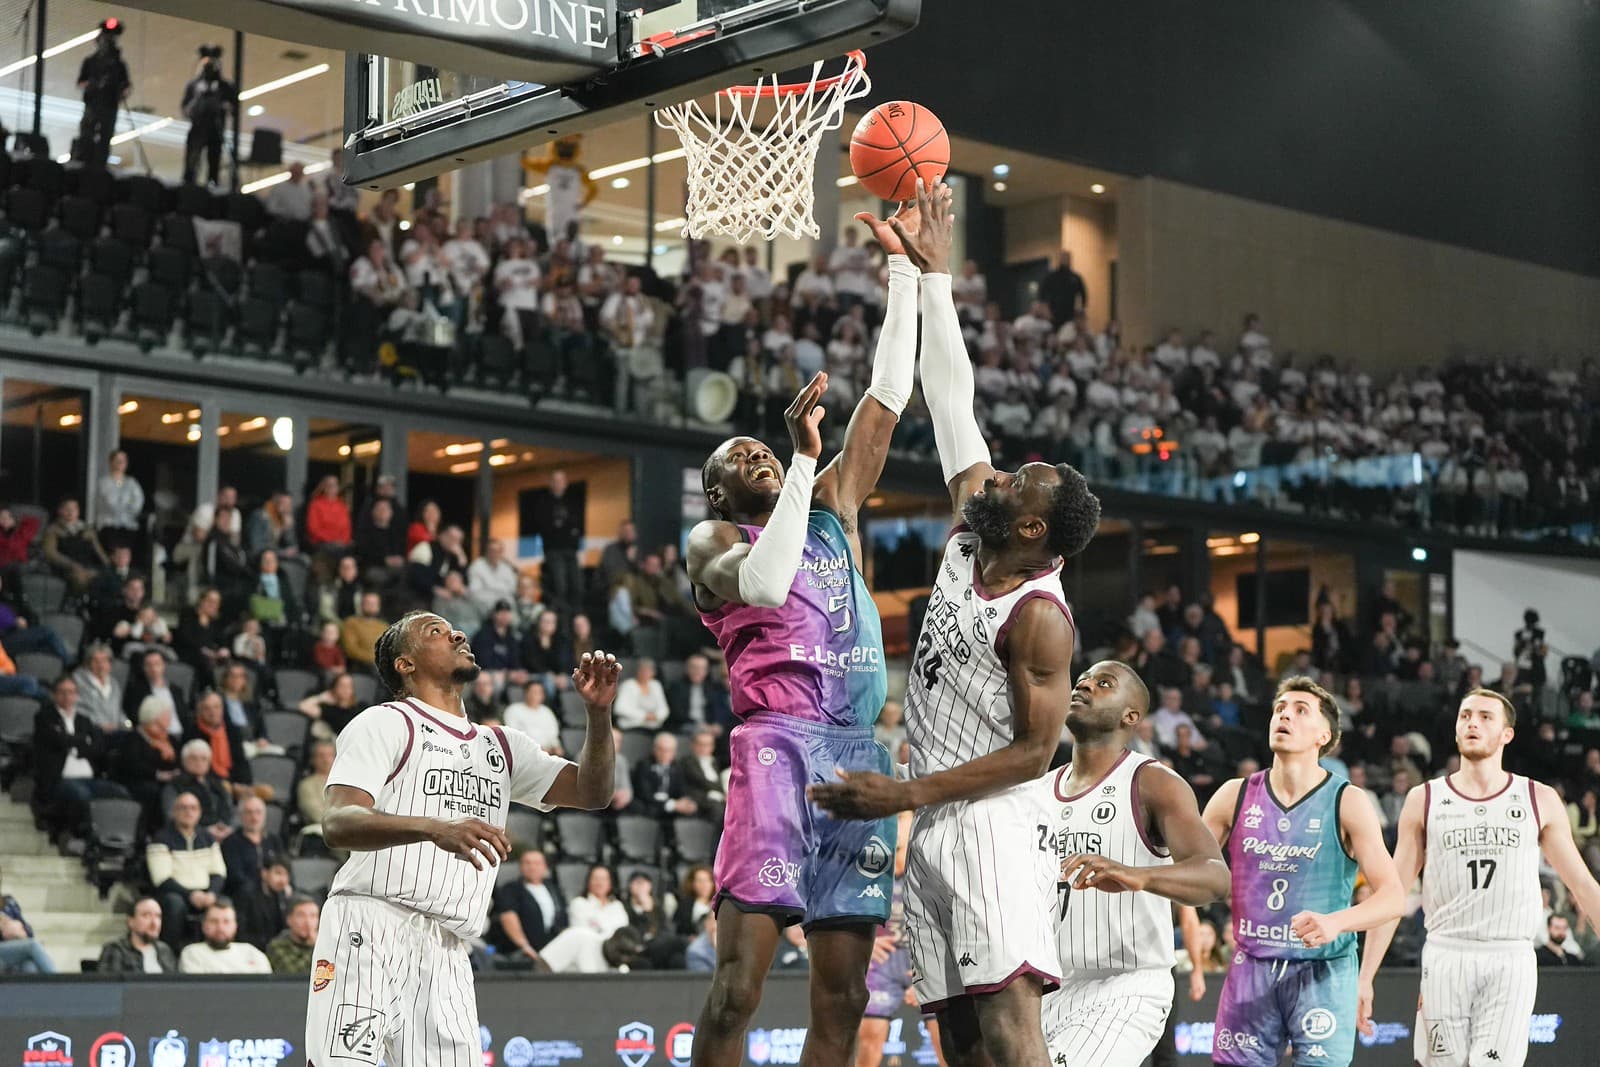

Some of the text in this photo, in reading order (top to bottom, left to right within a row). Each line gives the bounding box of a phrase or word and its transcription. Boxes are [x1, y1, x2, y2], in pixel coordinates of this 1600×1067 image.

[828, 592, 851, 632] 5
[927, 583, 971, 665] RLÉANS
[789, 643, 878, 673] E.Lecerc
[913, 631, 943, 692] 24
[1037, 824, 1059, 855] 24
[1059, 826, 1102, 859] ÉANS
[1242, 837, 1322, 862] Périgord
[1443, 820, 1521, 850] ORLÉANS
[1466, 859, 1497, 890] 17
[1266, 878, 1289, 911] 8
[228, 1038, 285, 1059] GAME
